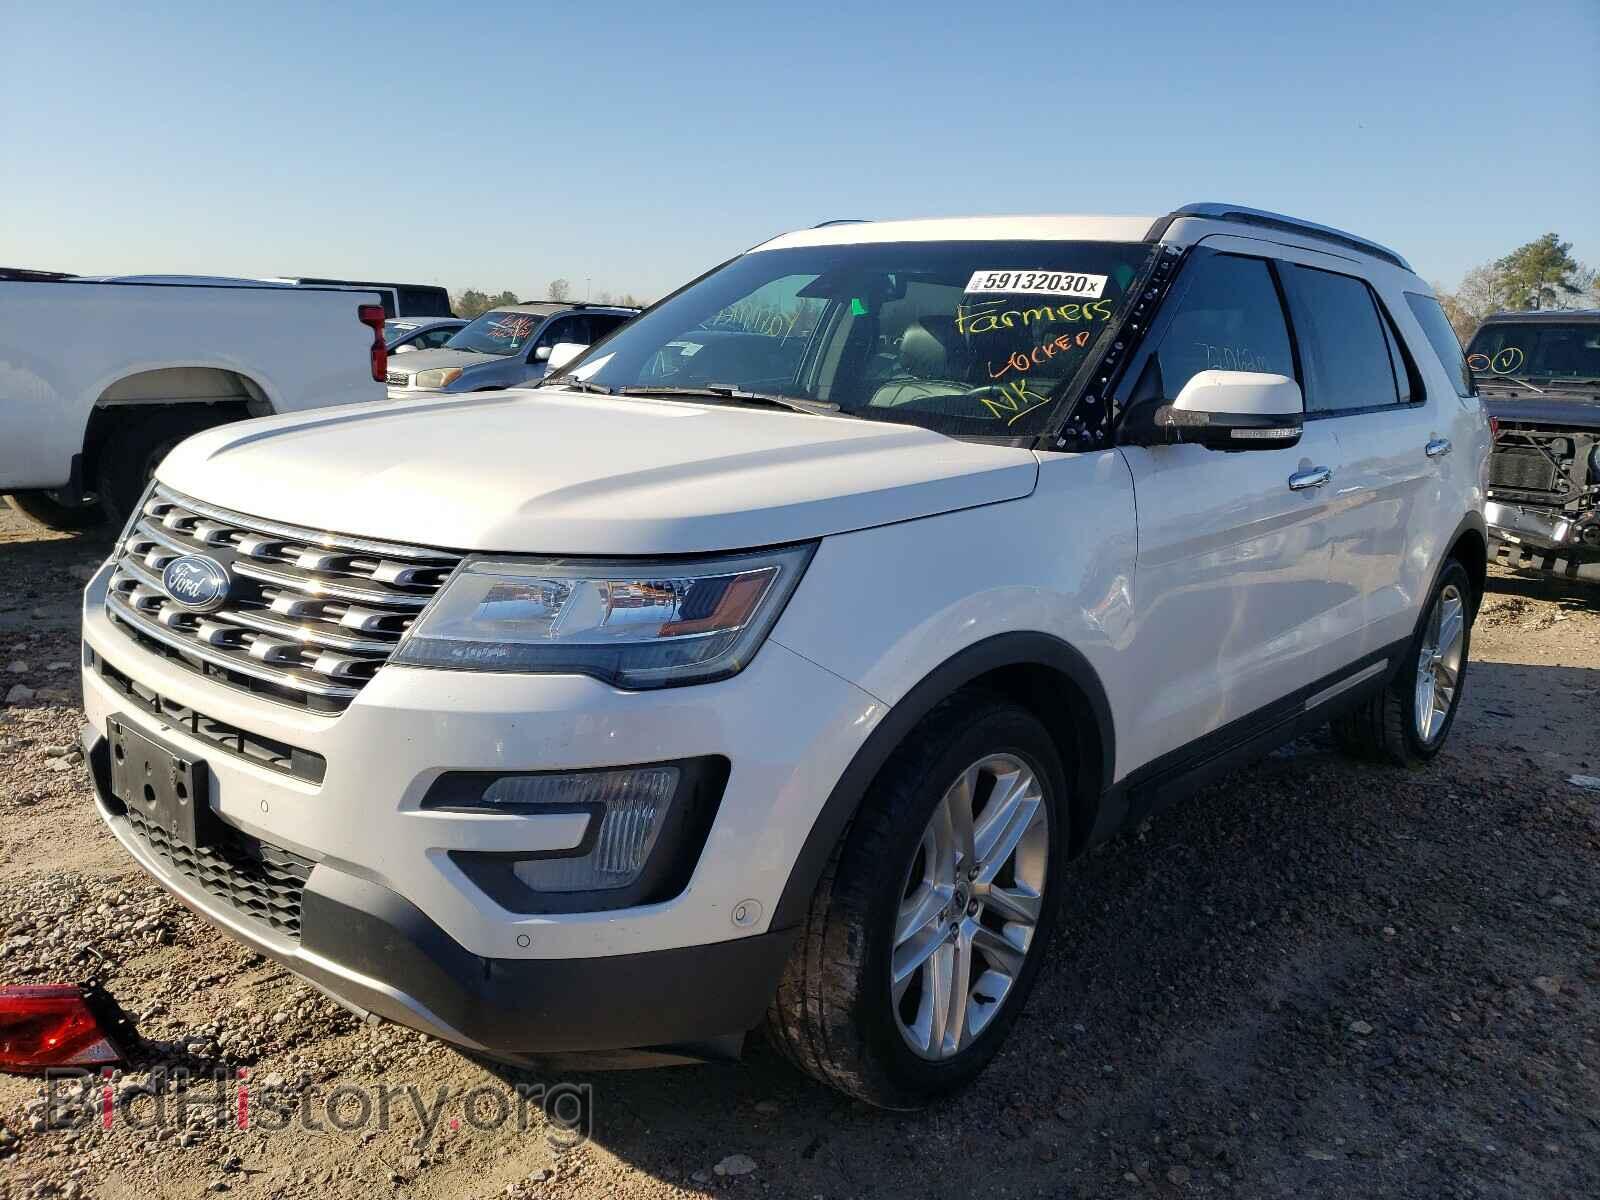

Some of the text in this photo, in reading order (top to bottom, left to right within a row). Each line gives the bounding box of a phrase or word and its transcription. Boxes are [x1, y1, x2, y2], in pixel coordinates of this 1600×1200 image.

[955, 299, 1112, 335] Farmers
[987, 331, 1090, 378] LOCKED
[169, 562, 206, 598] Ford
